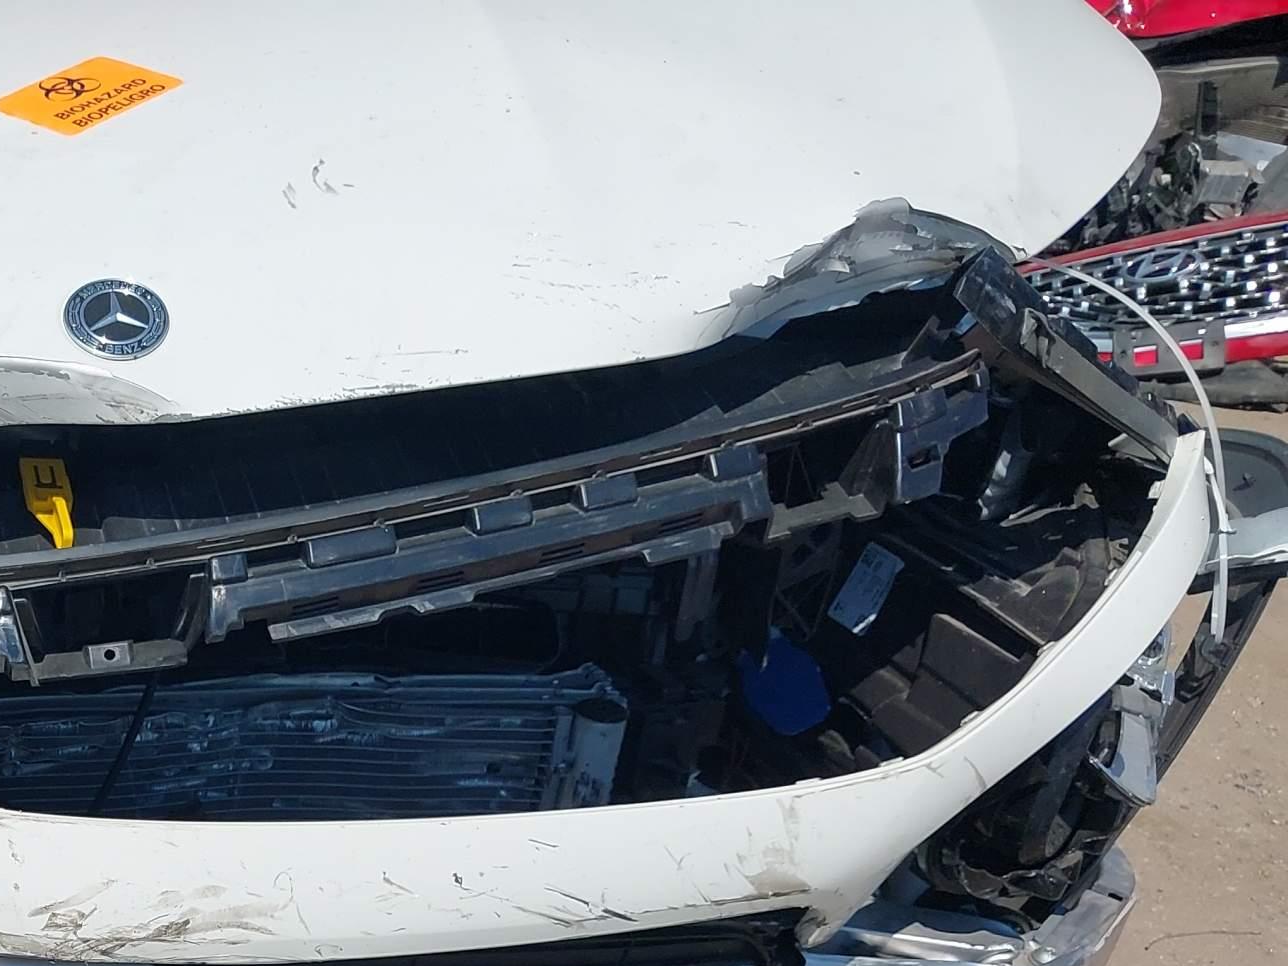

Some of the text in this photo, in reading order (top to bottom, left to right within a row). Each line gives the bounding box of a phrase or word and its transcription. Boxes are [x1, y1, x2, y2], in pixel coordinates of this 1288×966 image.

[53, 78, 147, 121] BIOHAZARD
[71, 84, 166, 128] BIOPELIGRO
[104, 342, 142, 355] BENZ
